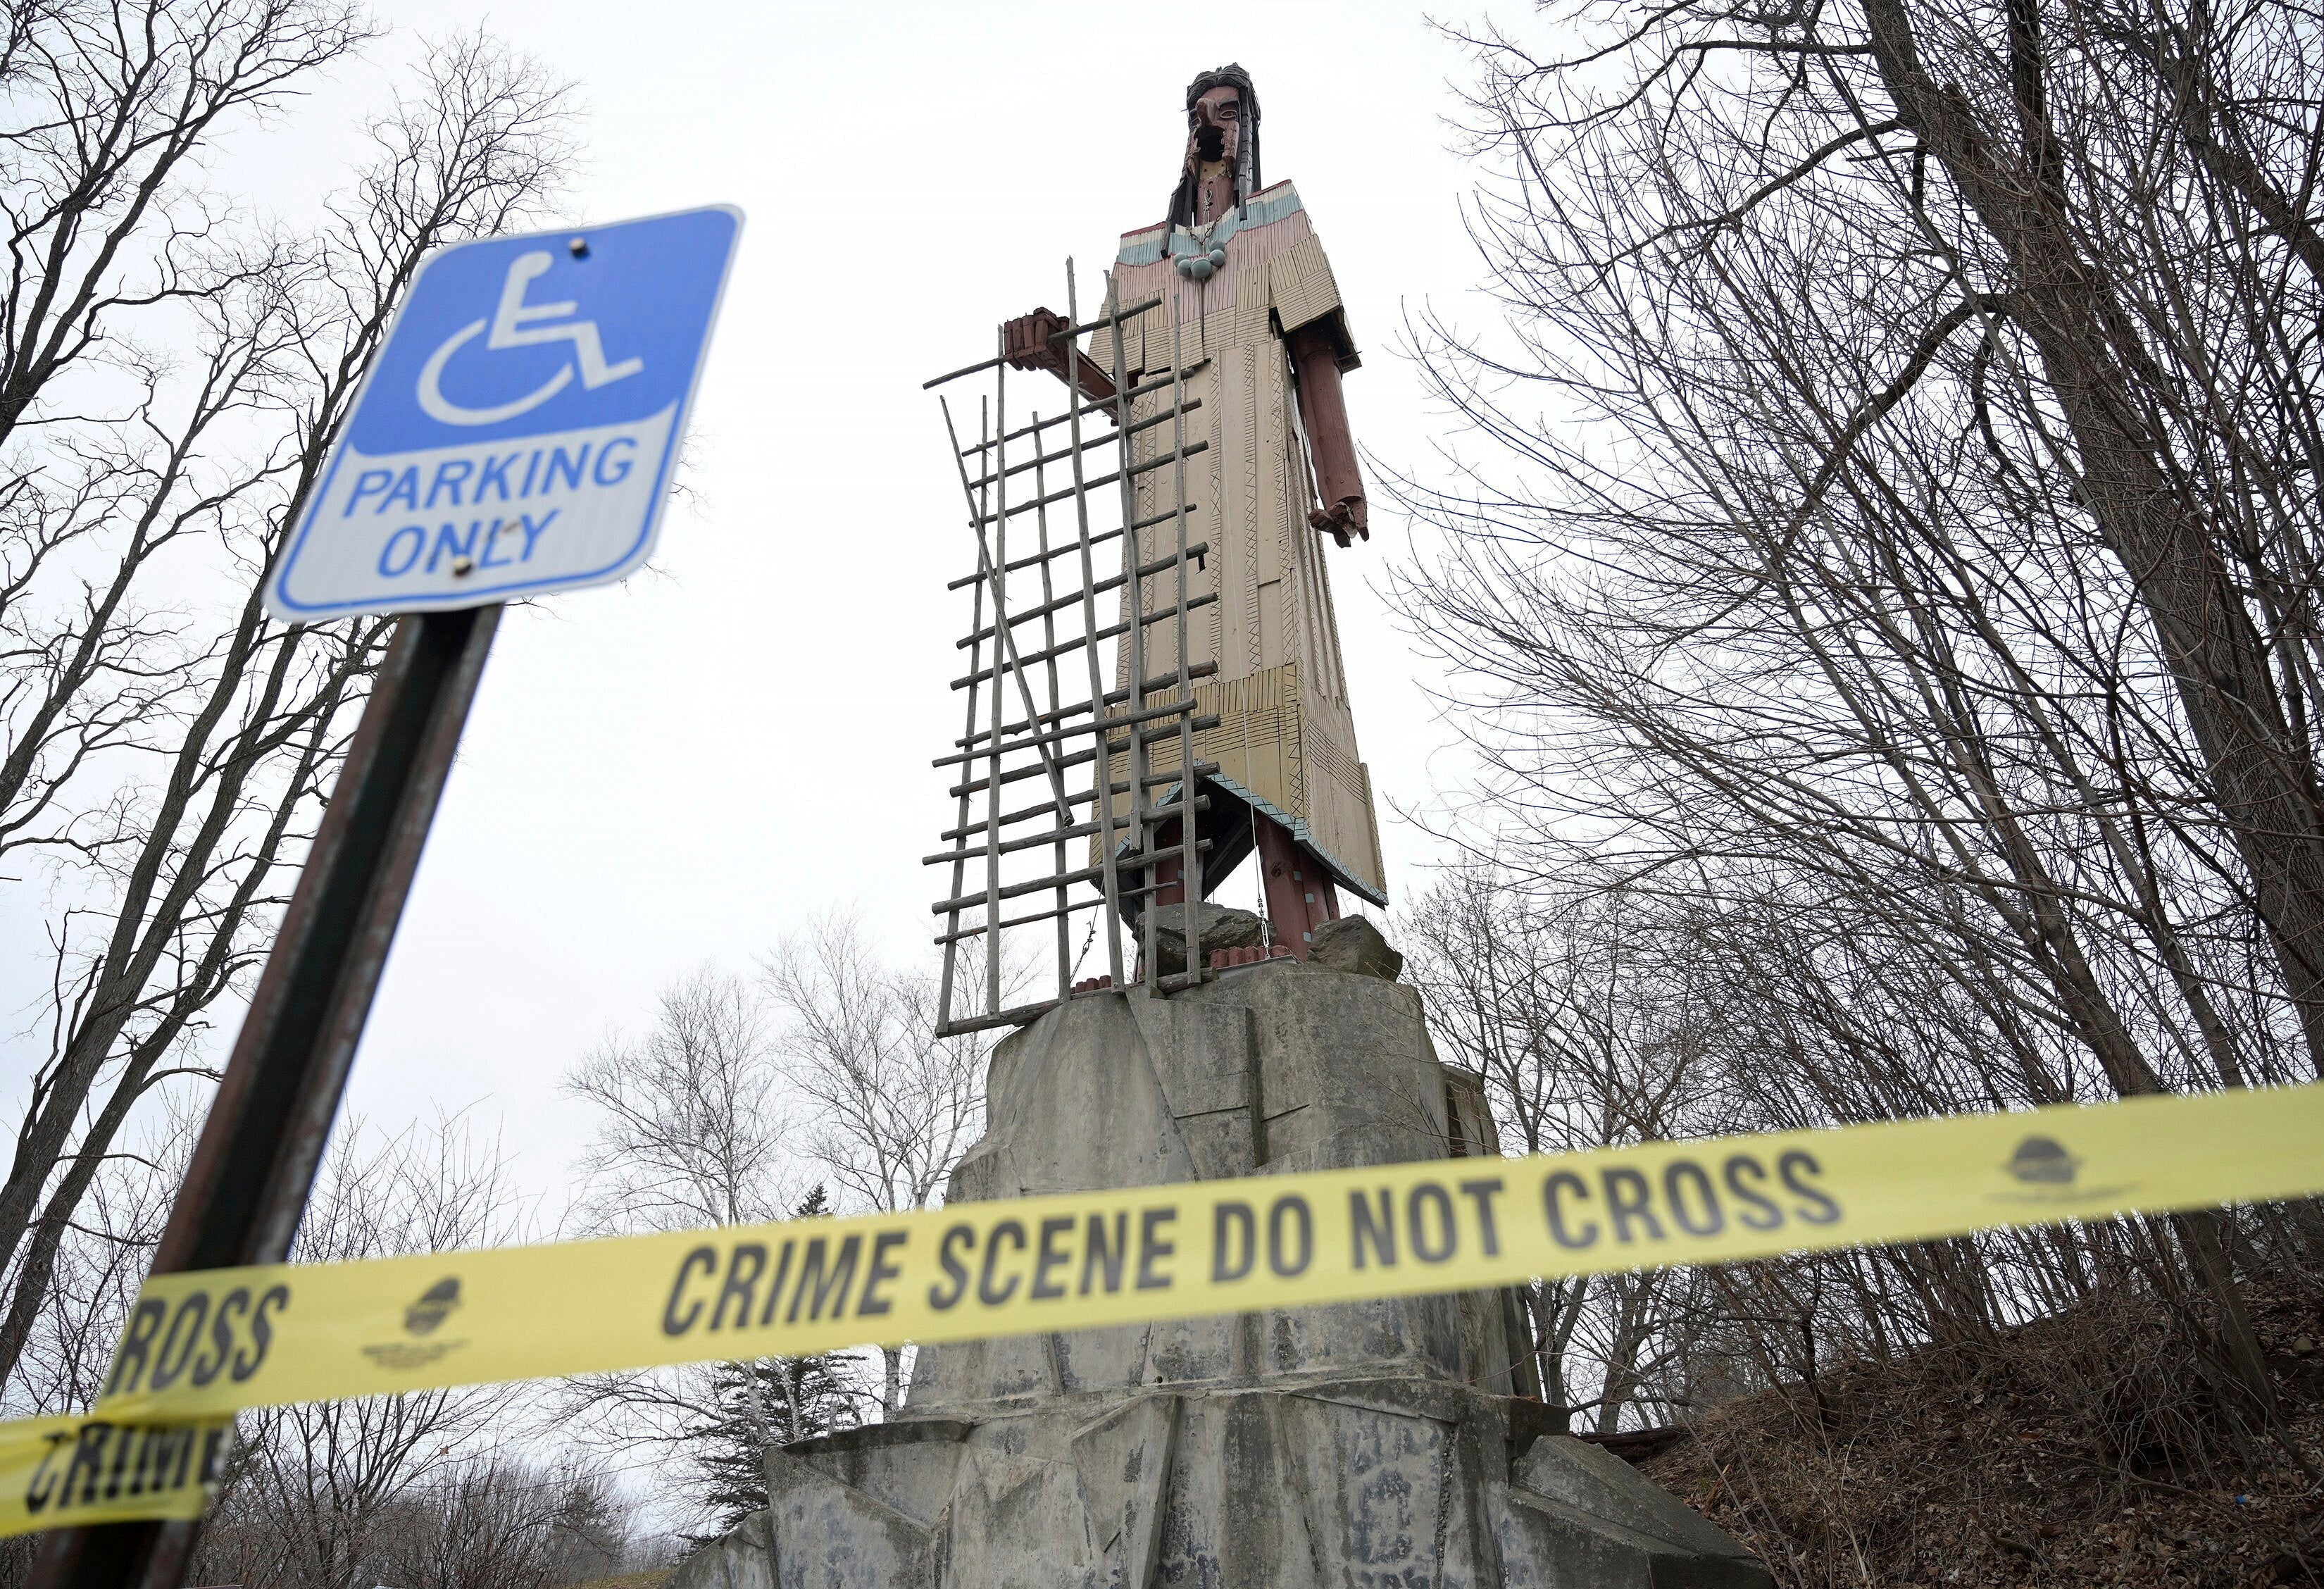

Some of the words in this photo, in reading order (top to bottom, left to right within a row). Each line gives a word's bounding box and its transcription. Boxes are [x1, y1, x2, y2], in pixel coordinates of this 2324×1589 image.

[342, 437, 637, 518] PARKING
[377, 508, 561, 578] ONLY
[663, 1233, 907, 1337] CRIME
[930, 1206, 1177, 1310] SCENE
[1213, 1197, 1313, 1282] DO
[1348, 1180, 1504, 1269] NOT
[1545, 1147, 1842, 1249] CROSS
[107, 1284, 289, 1395] ROSS
